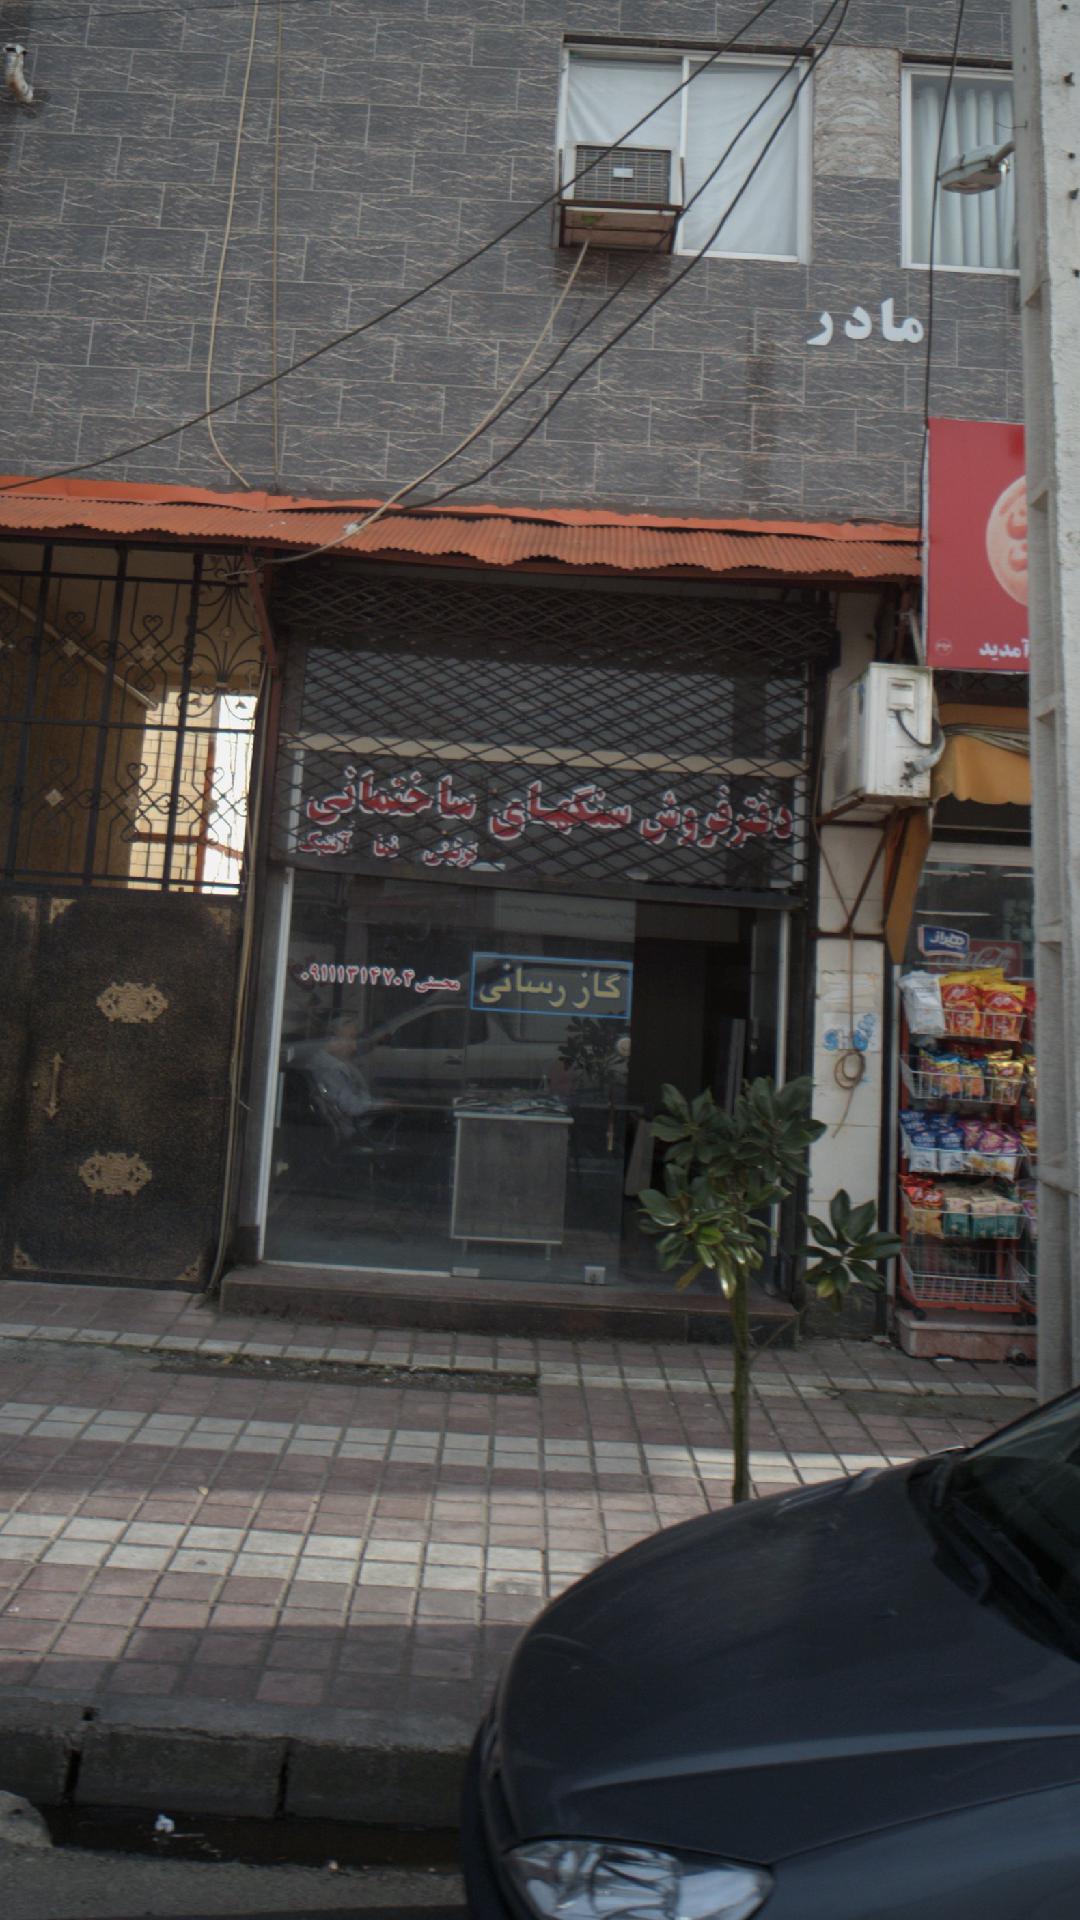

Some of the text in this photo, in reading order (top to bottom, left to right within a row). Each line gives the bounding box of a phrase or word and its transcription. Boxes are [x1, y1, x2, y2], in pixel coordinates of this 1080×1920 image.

[806, 297, 924, 346] مادر
[979, 638, 1029, 661] آمدید
[306, 765, 793, 848] دفتر فروش سنگهای ساختمانی
[415, 976, 461, 993] محسنی
[479, 962, 622, 1009] گاز رسانی
